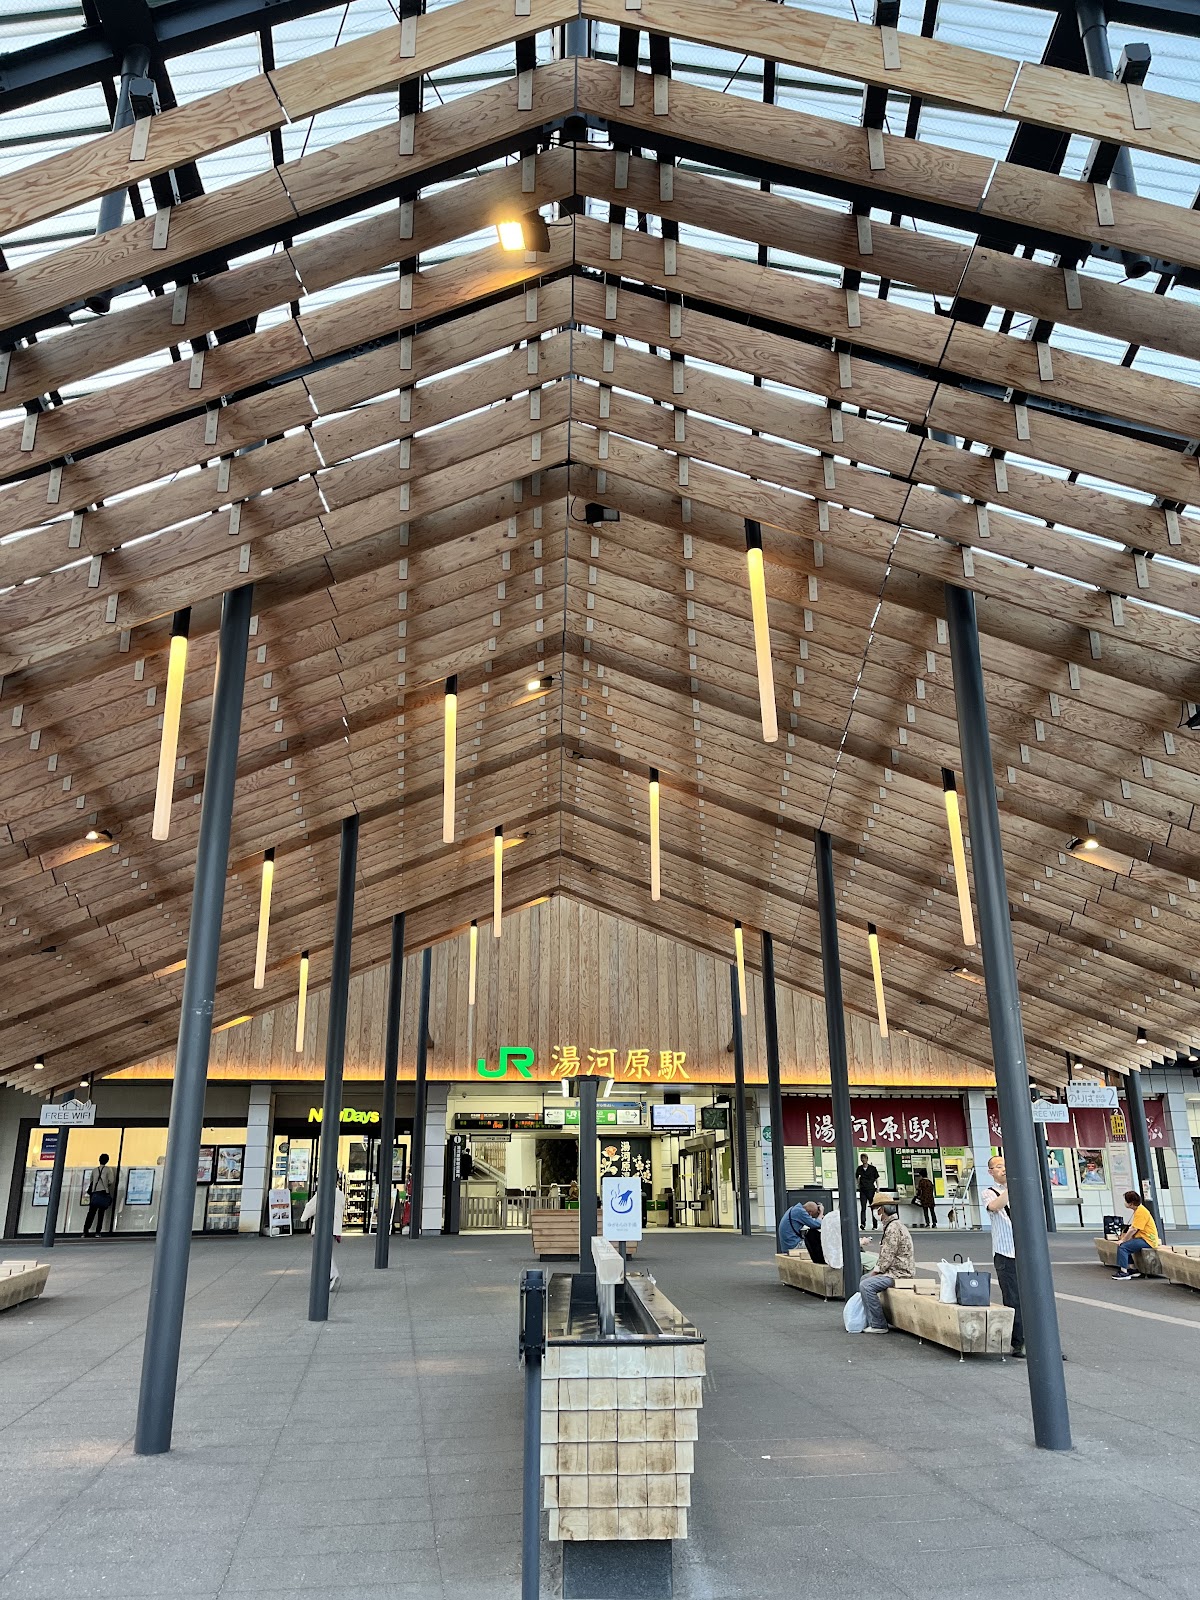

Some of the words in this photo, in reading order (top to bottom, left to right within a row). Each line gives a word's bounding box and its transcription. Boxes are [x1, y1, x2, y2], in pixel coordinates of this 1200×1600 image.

[477, 1046, 535, 1078] JR
[550, 1045, 690, 1080] 湯河原駅
[1106, 1088, 1116, 1106] 2
[45, 1112, 70, 1120] FREE
[72, 1112, 91, 1120] WIFI
[308, 1107, 380, 1124] NDays
[815, 1114, 934, 1143] 湯河原駅
